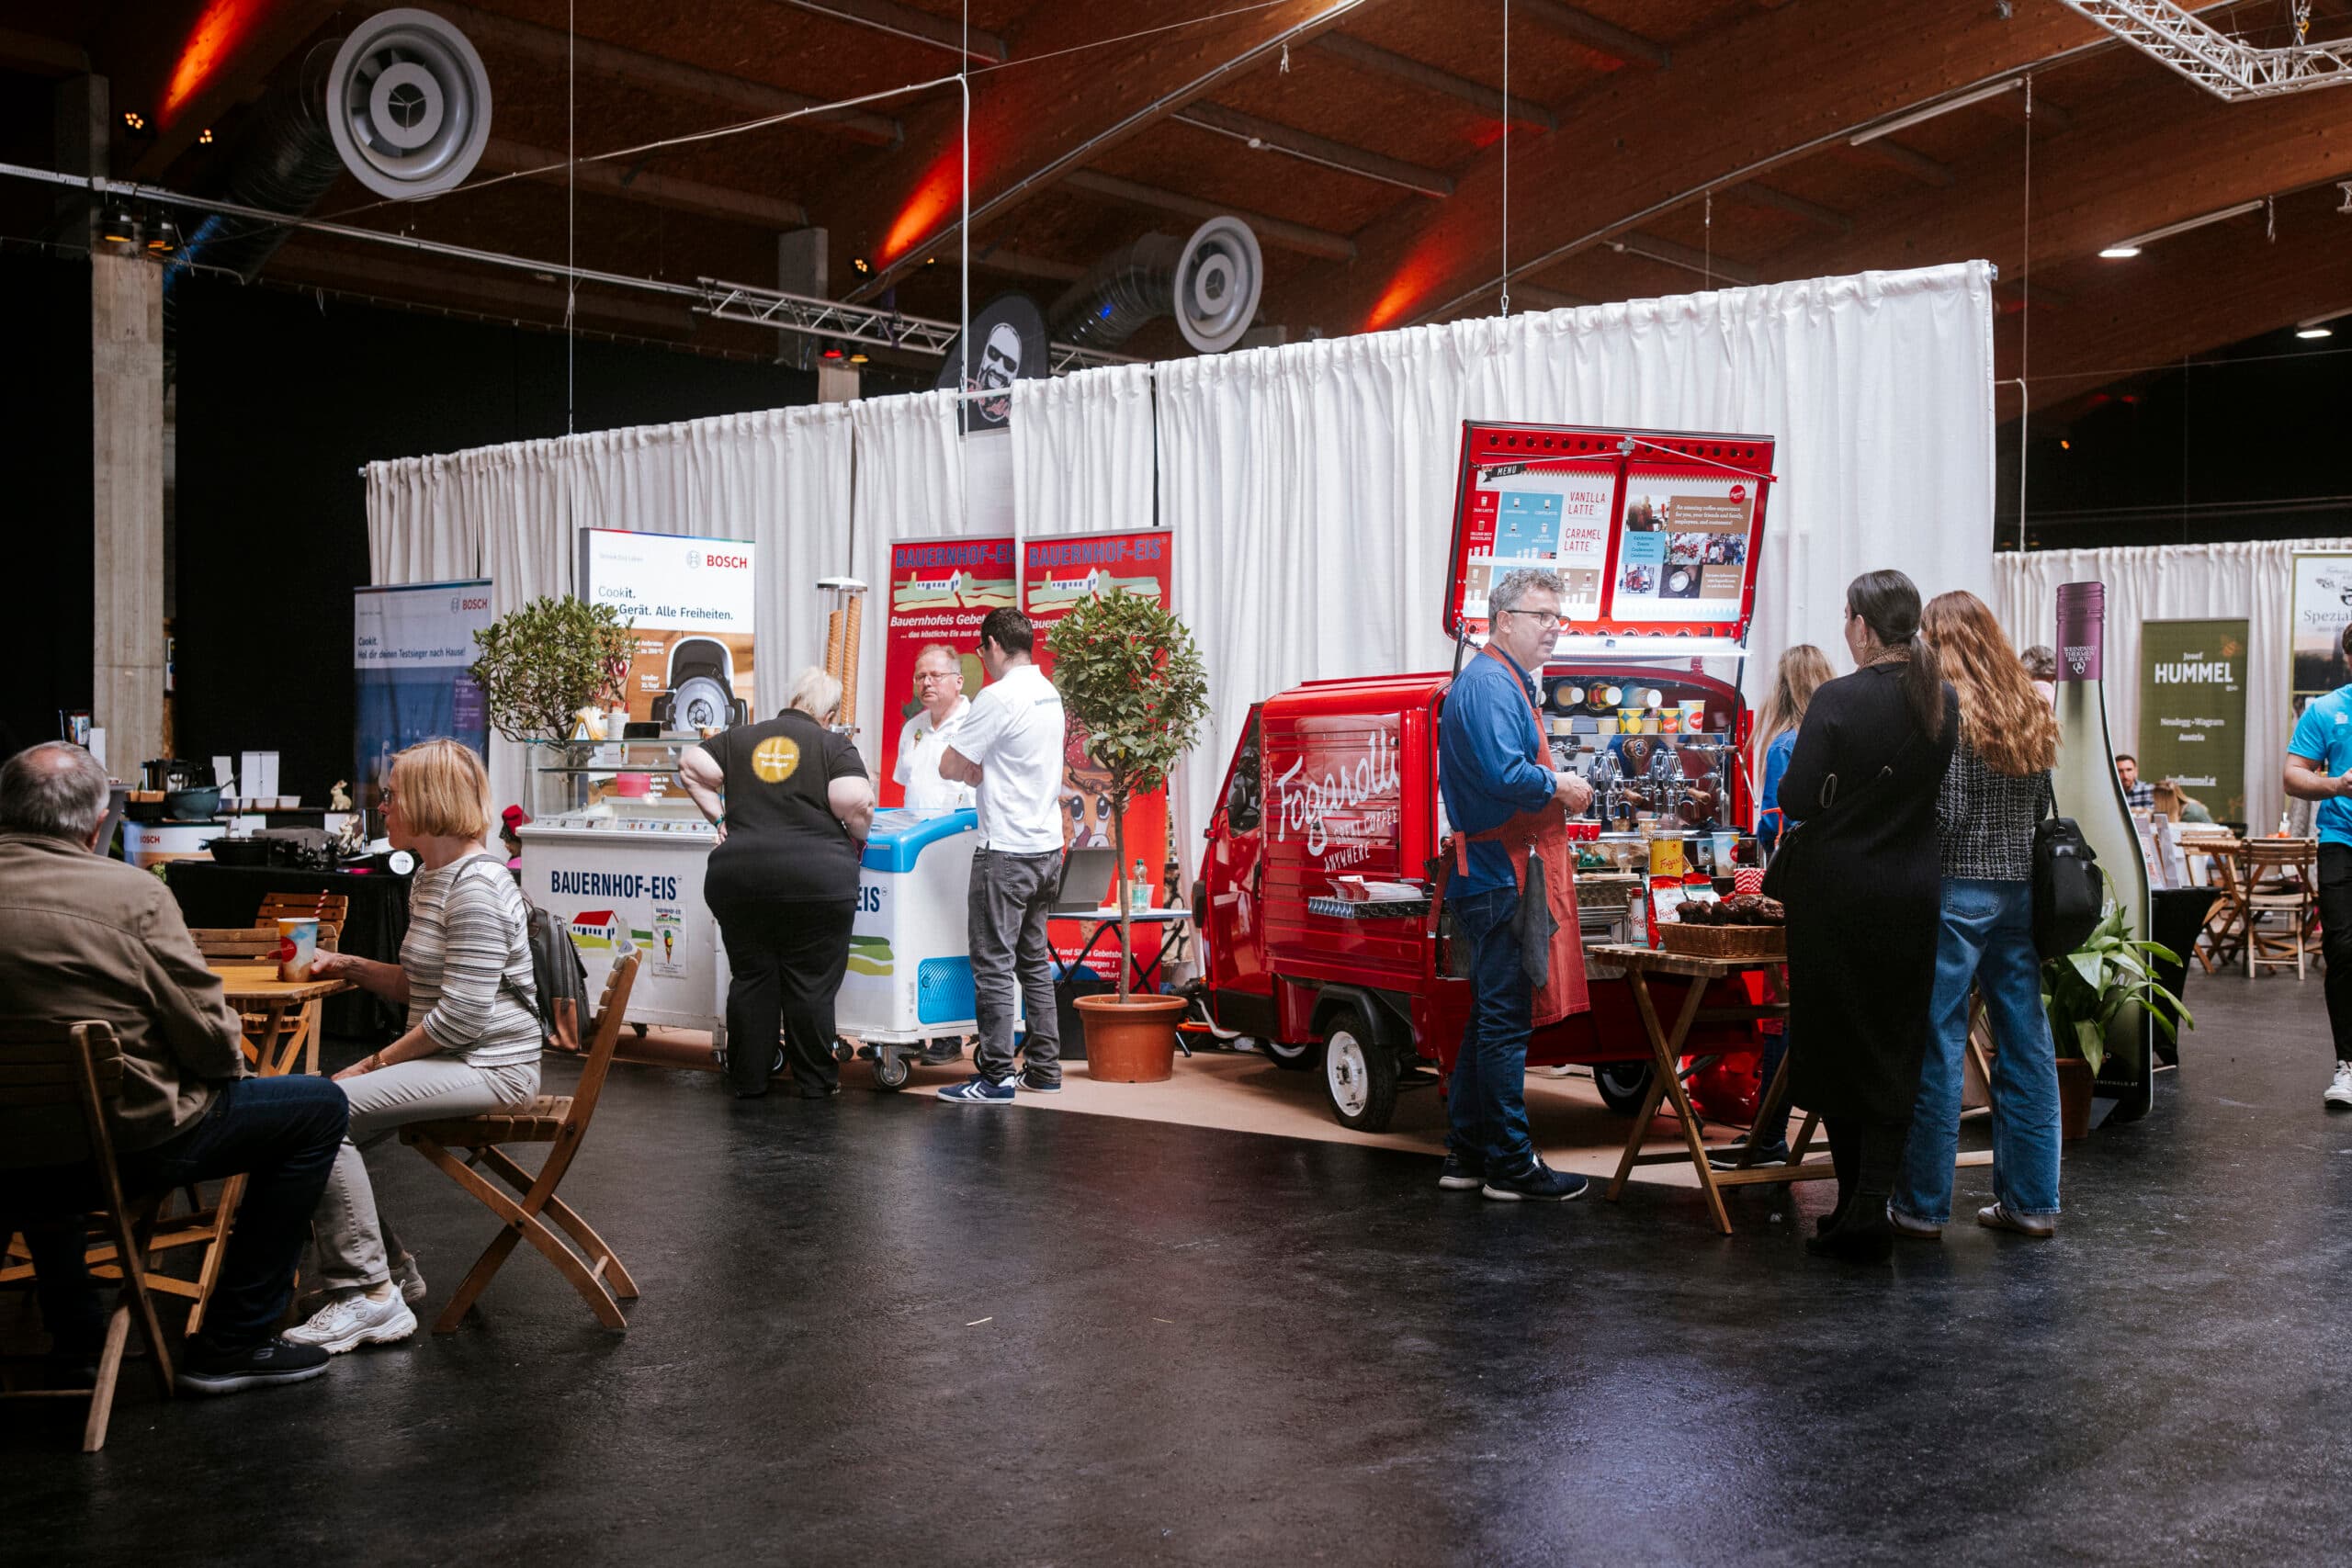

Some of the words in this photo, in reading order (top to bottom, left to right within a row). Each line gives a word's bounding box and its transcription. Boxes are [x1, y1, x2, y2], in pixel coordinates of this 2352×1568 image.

[1497, 465, 1518, 477] MENU
[1569, 491, 1606, 503] VANILLA
[1567, 504, 1594, 515] LATTE
[1565, 528, 1601, 540] CARAMEL
[1564, 540, 1590, 551] LATTE
[1028, 538, 1161, 568] BAUERNHOF-EIS
[706, 554, 748, 570] BOSCH
[597, 585, 637, 600] Cookit.
[461, 598, 489, 611] BOSCH
[618, 603, 652, 616] Gerät.
[655, 605, 677, 618] Alle
[680, 607, 734, 620] Freiheiten.
[889, 614, 955, 626] Bauernhofeis
[956, 613, 987, 625] Gebet
[908, 630, 920, 638] das
[920, 629, 949, 638] köstliche
[949, 629, 958, 637] Eis
[972, 628, 982, 637] de
[357, 649, 368, 660] Hol
[368, 648, 378, 660] dir
[379, 647, 398, 659] deinen
[399, 647, 428, 660] Testsieger
[429, 647, 444, 658] nach
[445, 646, 467, 658] Hause!
[2154, 661, 2233, 684] HUMMEL
[1275, 727, 1400, 857] Fogarolli
[1333, 819, 1362, 845] GREAT
[1364, 806, 1399, 835] COFFEE
[1324, 840, 1371, 874] ANYWHERE
[551, 870, 677, 901] BAUERNHOF-EIS
[1059, 947, 1073, 956] und
